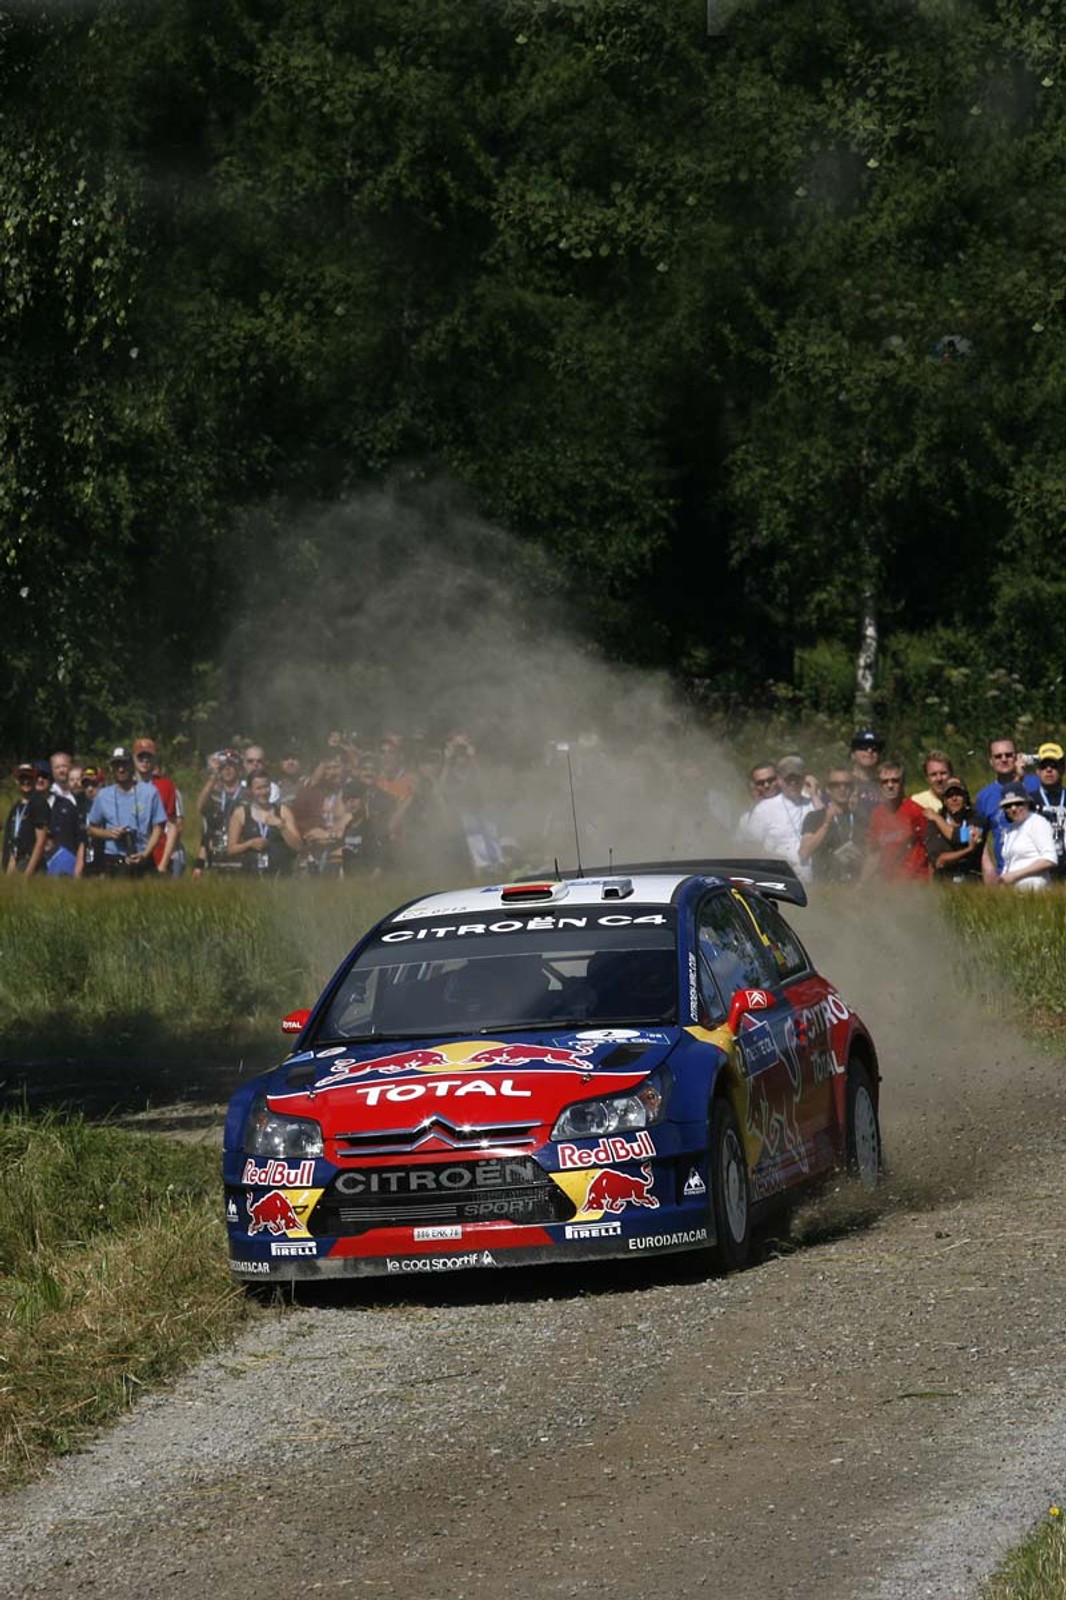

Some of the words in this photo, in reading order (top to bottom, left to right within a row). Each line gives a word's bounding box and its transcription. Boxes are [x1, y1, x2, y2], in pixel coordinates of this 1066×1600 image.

[381, 916, 588, 942] CITROËN
[597, 914, 668, 926] C4
[282, 1020, 303, 1029] OTAL
[803, 993, 855, 1040] CITRO
[357, 1080, 532, 1106] TOTAL
[557, 1138, 610, 1169] Red
[610, 1131, 656, 1165] Bull
[336, 1160, 534, 1193] CITROËN
[464, 1201, 536, 1216] SPORT
[565, 1221, 623, 1239] PIRELLI
[628, 1228, 708, 1250] EURODATACAR
[270, 1241, 317, 1256] PIRELLI
[386, 1259, 399, 1272] le
[402, 1258, 431, 1271] coq
[432, 1254, 477, 1271] sportif
